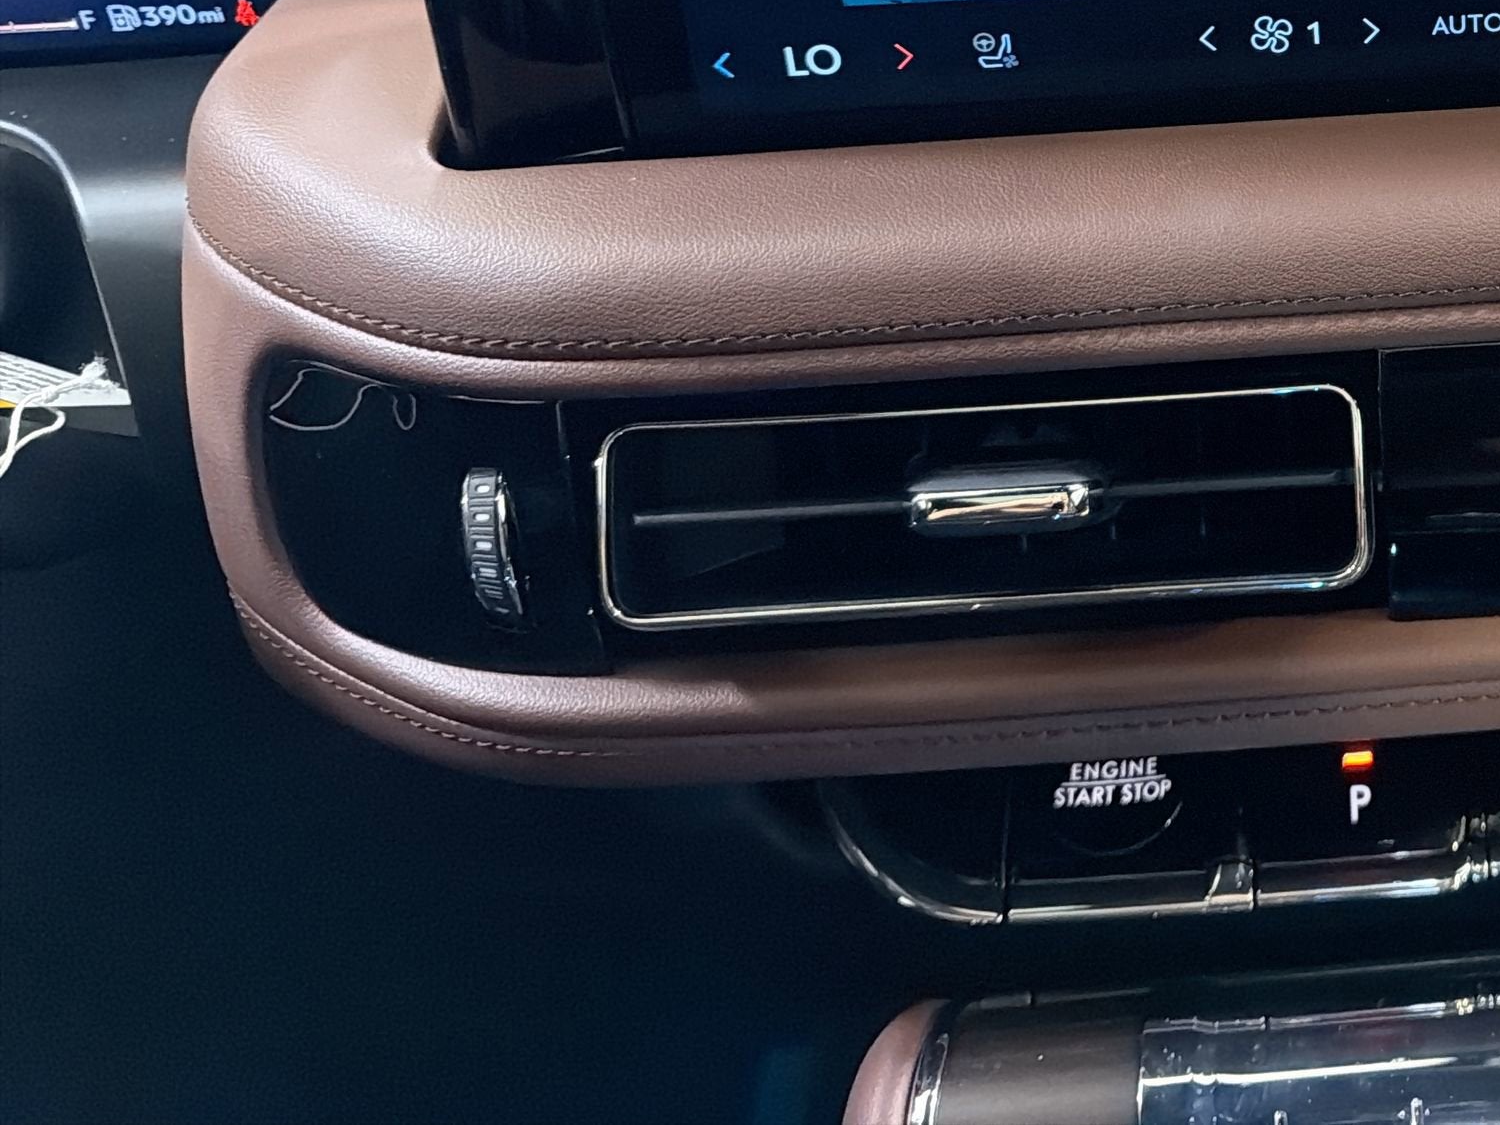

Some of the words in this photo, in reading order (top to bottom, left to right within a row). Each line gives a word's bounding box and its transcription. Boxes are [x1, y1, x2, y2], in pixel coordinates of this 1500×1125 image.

[78, 9, 97, 30] F
[139, 4, 196, 27] 390
[197, 6, 226, 24] mi
[1306, 21, 1320, 45] 1
[783, 43, 842, 77] LO
[1069, 756, 1158, 780] ENGINE
[1053, 785, 1116, 809] START
[1119, 778, 1172, 806] STOP
[1349, 784, 1372, 823] P
